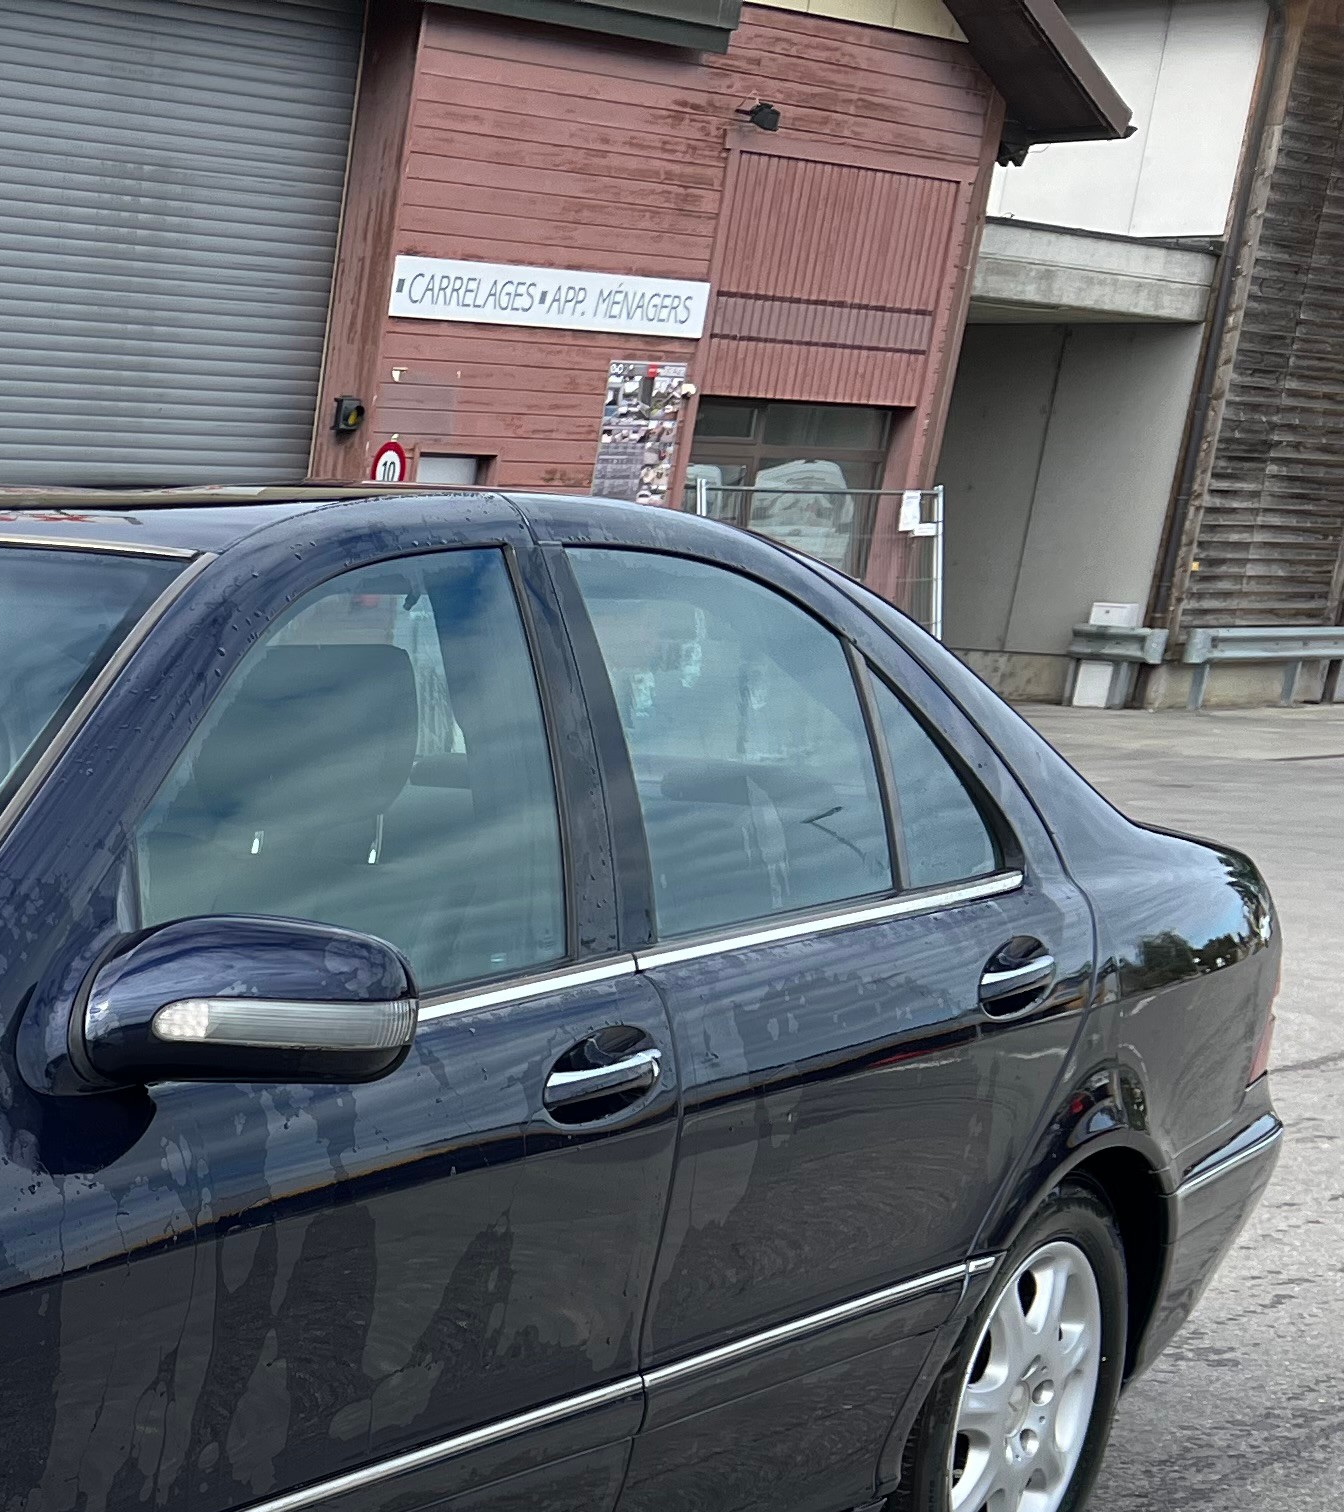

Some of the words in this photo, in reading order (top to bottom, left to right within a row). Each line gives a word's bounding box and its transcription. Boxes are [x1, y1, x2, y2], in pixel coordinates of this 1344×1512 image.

[408, 272, 537, 313] CARRELAGES
[545, 284, 588, 317] APP.
[592, 281, 693, 325] MÉNAGERS
[382, 460, 396, 481] 10
